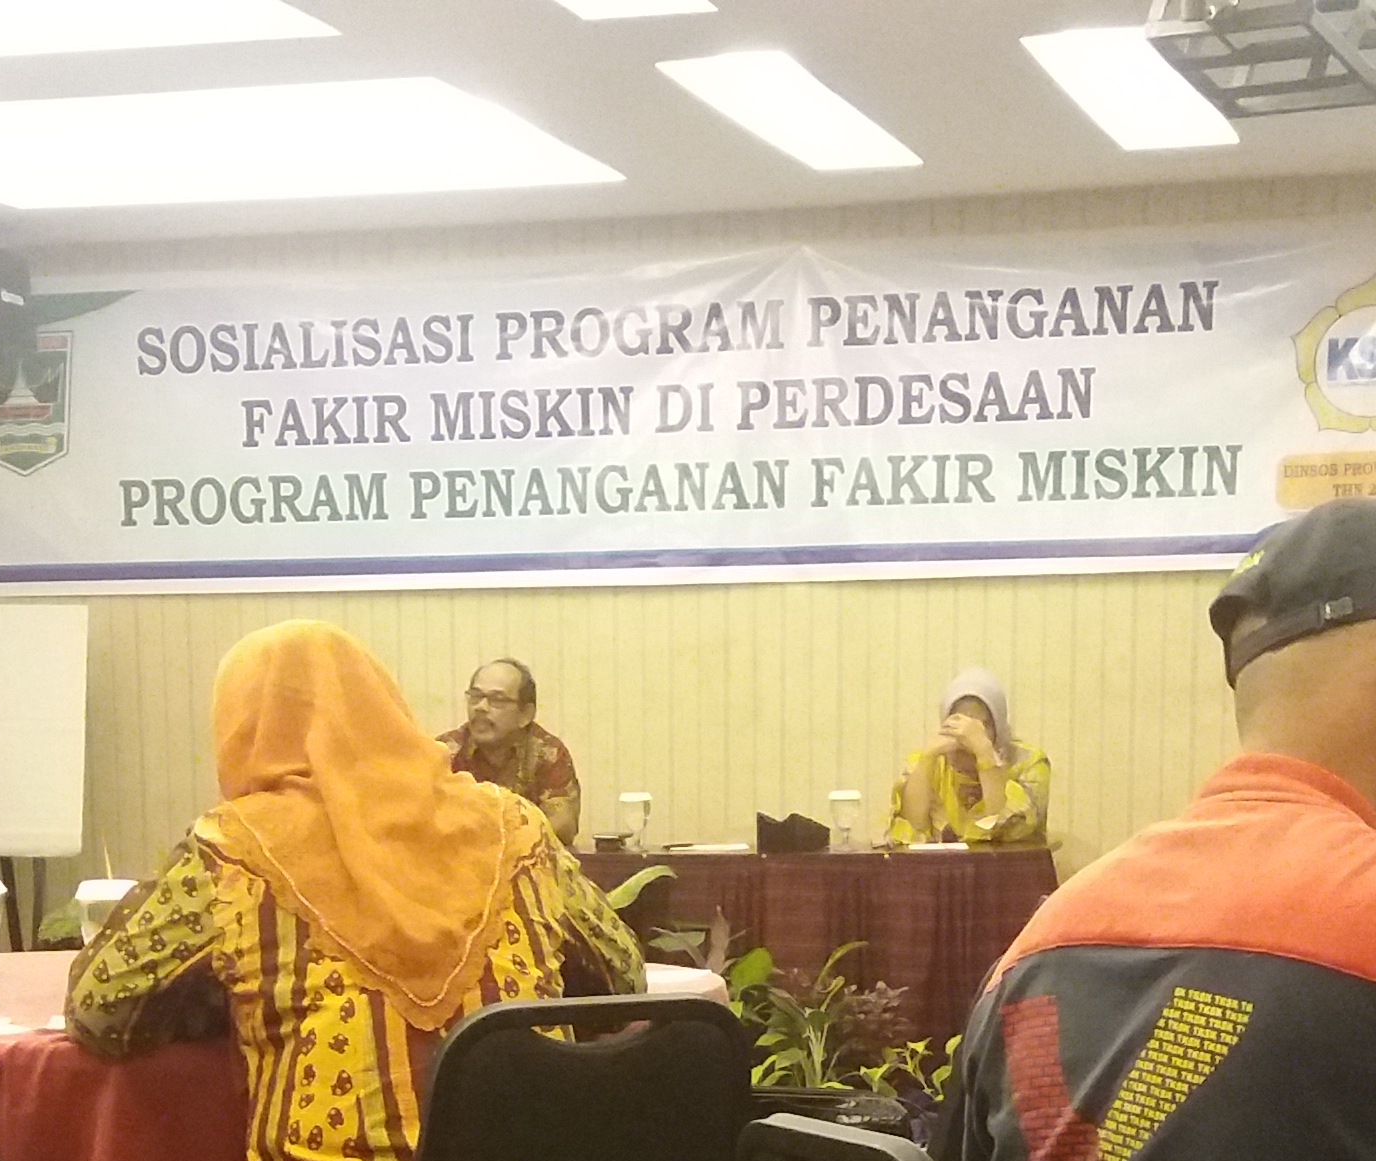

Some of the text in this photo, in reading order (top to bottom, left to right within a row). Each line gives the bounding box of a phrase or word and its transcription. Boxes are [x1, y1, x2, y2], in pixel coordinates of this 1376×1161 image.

[137, 280, 1220, 376] SOSIALISASI PROGRAM PENANGANAN
[240, 367, 1096, 448] FAKIR MISKIN DI PERDESAAN
[119, 444, 1243, 527] PROGRAM PENANGANAN FAKIR MISKIN
[1284, 463, 1338, 478] DINSOS
[1332, 483, 1363, 497] THN
